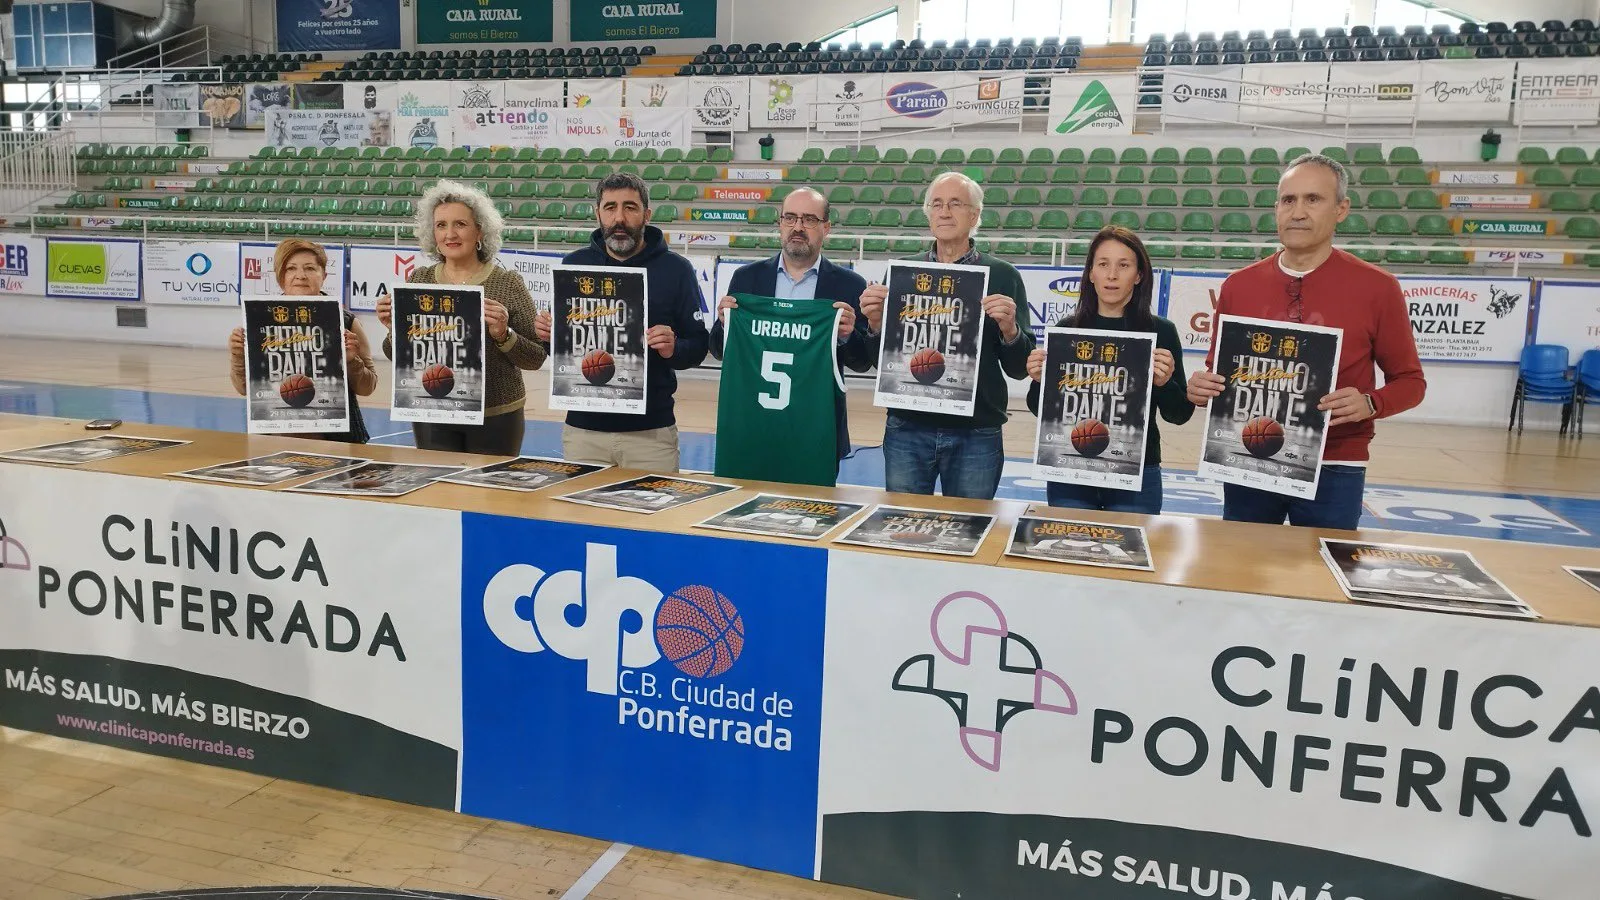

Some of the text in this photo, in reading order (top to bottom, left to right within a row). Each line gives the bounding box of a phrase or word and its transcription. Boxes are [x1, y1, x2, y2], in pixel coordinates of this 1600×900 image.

[447, 9, 521, 21] CAJA RURAL
[602, 3, 683, 18] CAJA RURAL
[297, 20, 320, 28] Felices
[334, 19, 351, 27] estos
[362, 18, 378, 26] años
[449, 30, 518, 40] somos El Bierzo
[605, 25, 680, 37] somos El Bierzo
[1521, 75, 1599, 87] ENTRENA
[1243, 86, 1259, 96] los
[506, 97, 559, 109] sanyclima
[895, 96, 946, 110] Paraño
[476, 108, 549, 125] atiendo
[1095, 109, 1120, 118] coebb
[567, 117, 584, 125] NOS
[636, 130, 659, 139] Junta
[614, 139, 642, 148] Castilla
[652, 139, 672, 147] León
[714, 190, 761, 200] Telenauto
[703, 212, 747, 220] CAJA RURAL
[1480, 222, 1545, 233] CAJA RURAL
[59, 265, 102, 275] CUEVAS
[162, 279, 240, 294] TU VISIÓN
[528, 280, 550, 296] DEPO
[1403, 287, 1478, 303] ARNICERÍAS
[1409, 303, 1459, 317] RAMI
[751, 319, 812, 341] URBANO
[757, 350, 794, 411] 5
[1043, 522, 1116, 537] URBANO
[37, 564, 408, 664] PONFERRADA
[618, 670, 795, 719] C.B. Ciudad de
[5, 668, 311, 741] MÁS SALUD. MÁS BIERZO
[618, 695, 795, 754] Ponferrada
[56, 711, 256, 763] www.clinicaponferrada.es
[1089, 706, 1592, 840] PONFERRA
[1017, 838, 1105, 880] MÁS
[1269, 879, 1370, 900] MÁ
